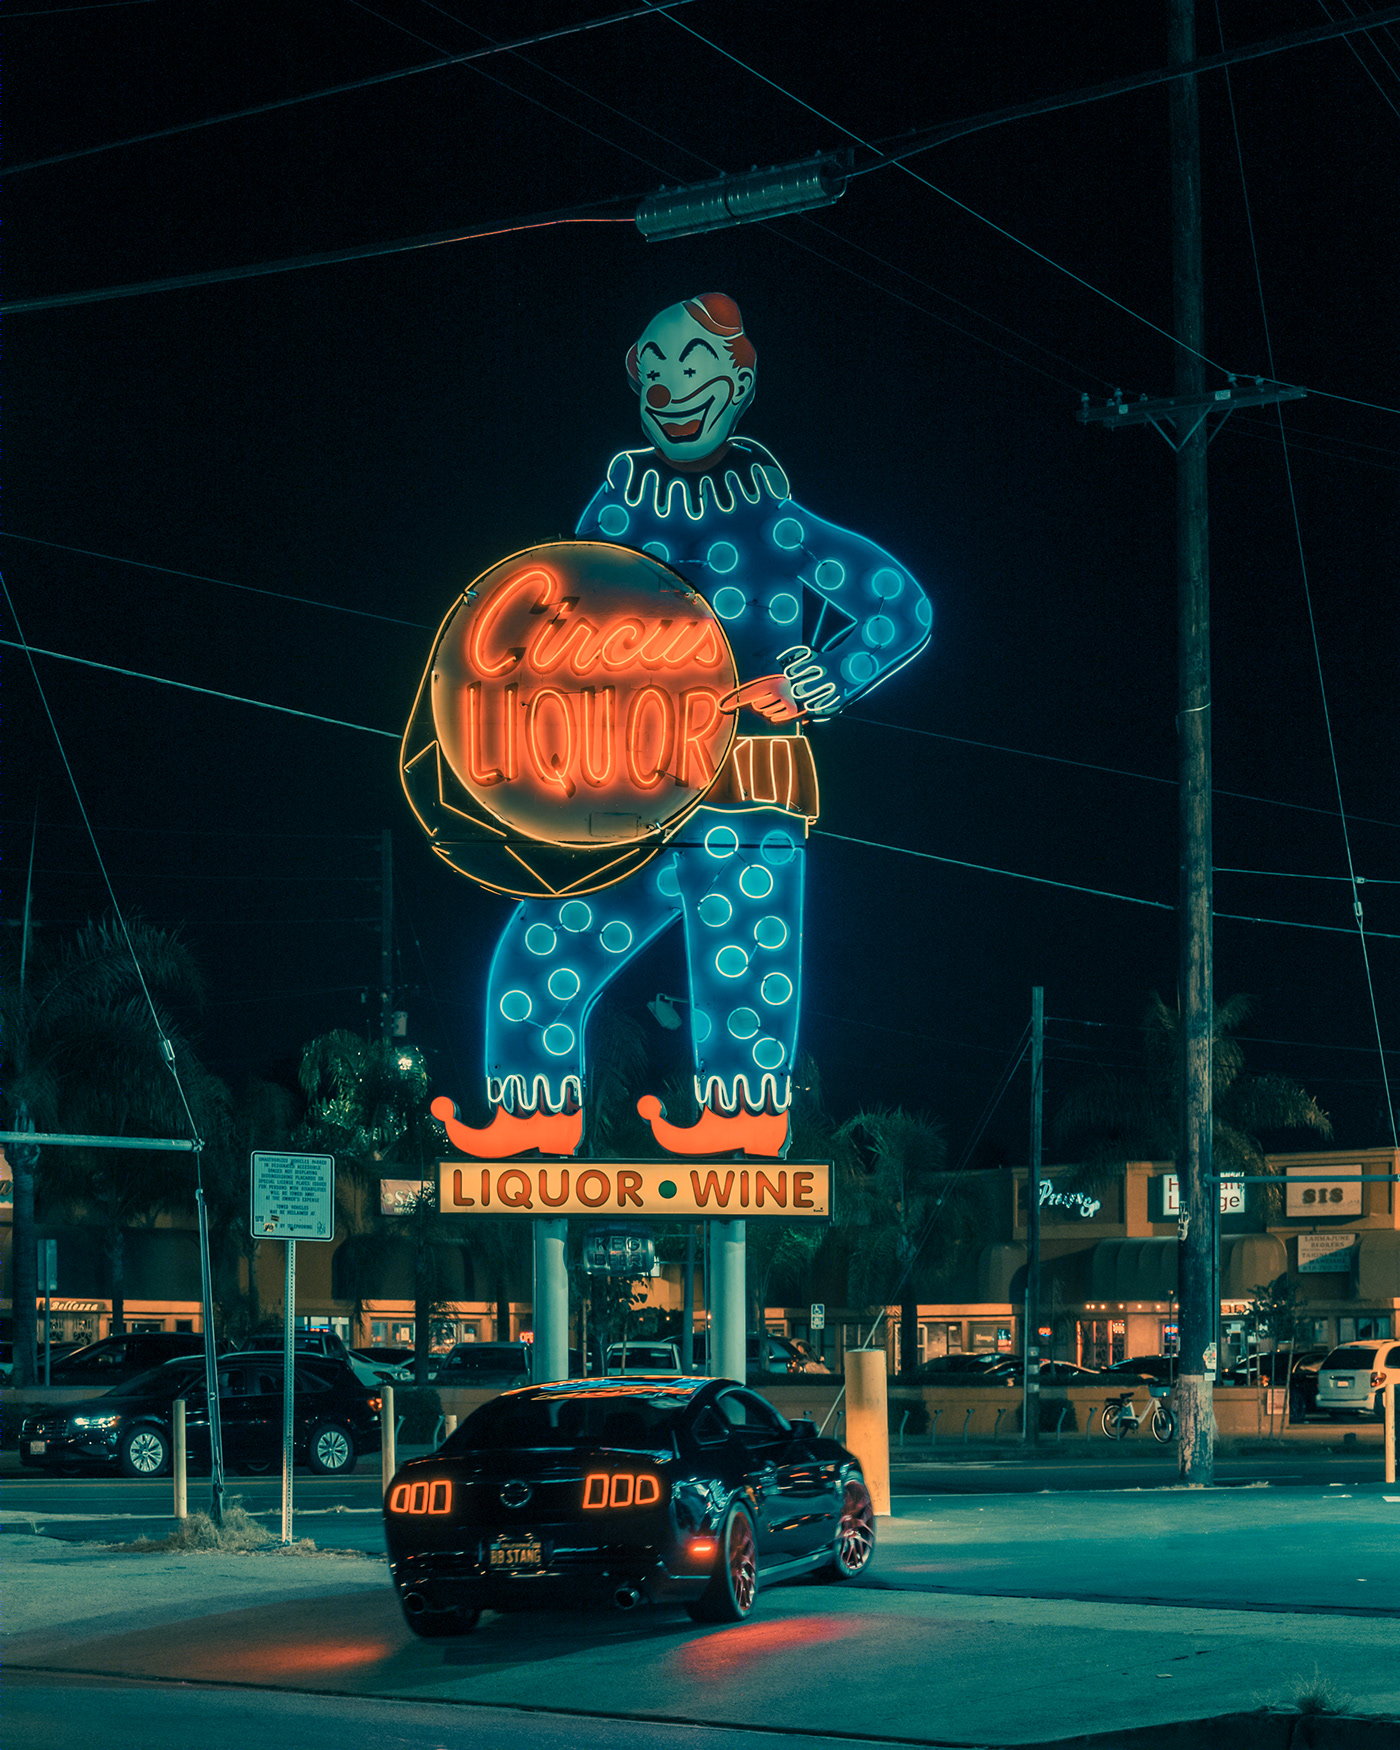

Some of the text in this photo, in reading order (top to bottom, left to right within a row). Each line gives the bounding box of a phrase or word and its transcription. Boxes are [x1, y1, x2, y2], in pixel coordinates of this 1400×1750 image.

[470, 566, 723, 678] Circus
[467, 682, 723, 798] LIQUOR
[453, 1168, 815, 1210] LIQUOR WINE
[1302, 1187, 1343, 1204] SIS
[594, 1236, 641, 1252] KEG
[594, 1253, 643, 1268] BEER
